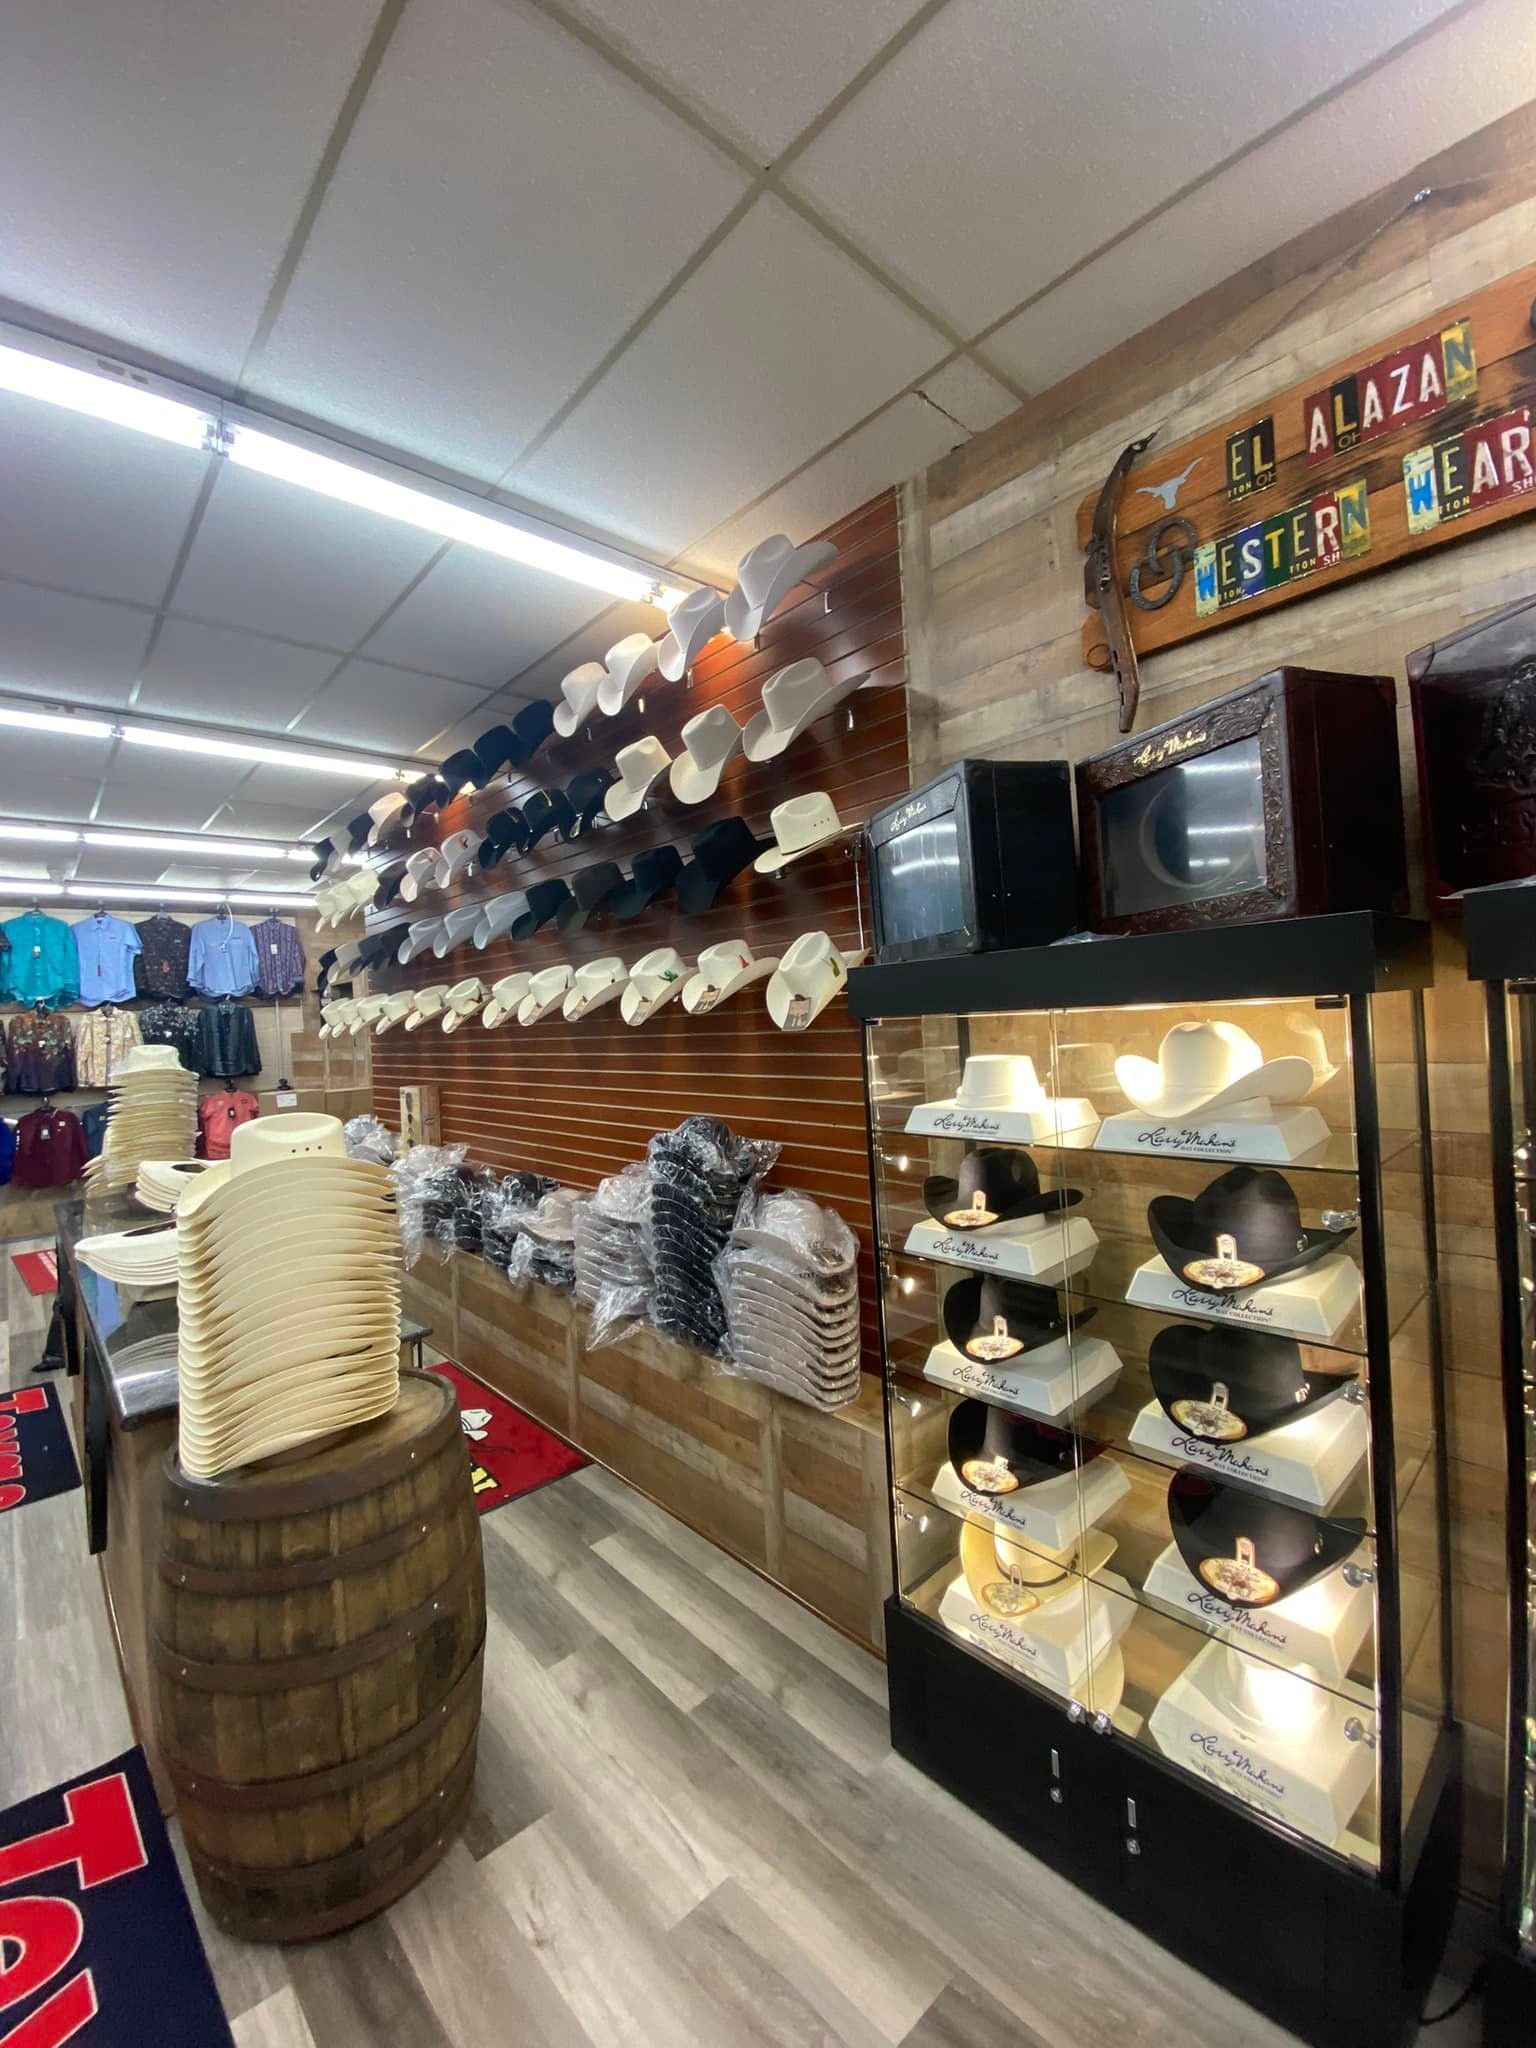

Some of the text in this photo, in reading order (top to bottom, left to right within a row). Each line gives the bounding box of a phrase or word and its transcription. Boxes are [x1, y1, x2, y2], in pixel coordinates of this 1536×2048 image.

[1232, 335, 1474, 481] EL ALAZAN
[1197, 425, 1534, 602] WESTERN WEAR
[1137, 1127, 1185, 1149] Larry
[1172, 1288, 1221, 1311] Larry
[1171, 1437, 1219, 1462] Larry
[1187, 1592, 1235, 1622] Larry
[1190, 1733, 1236, 1767] Larry
